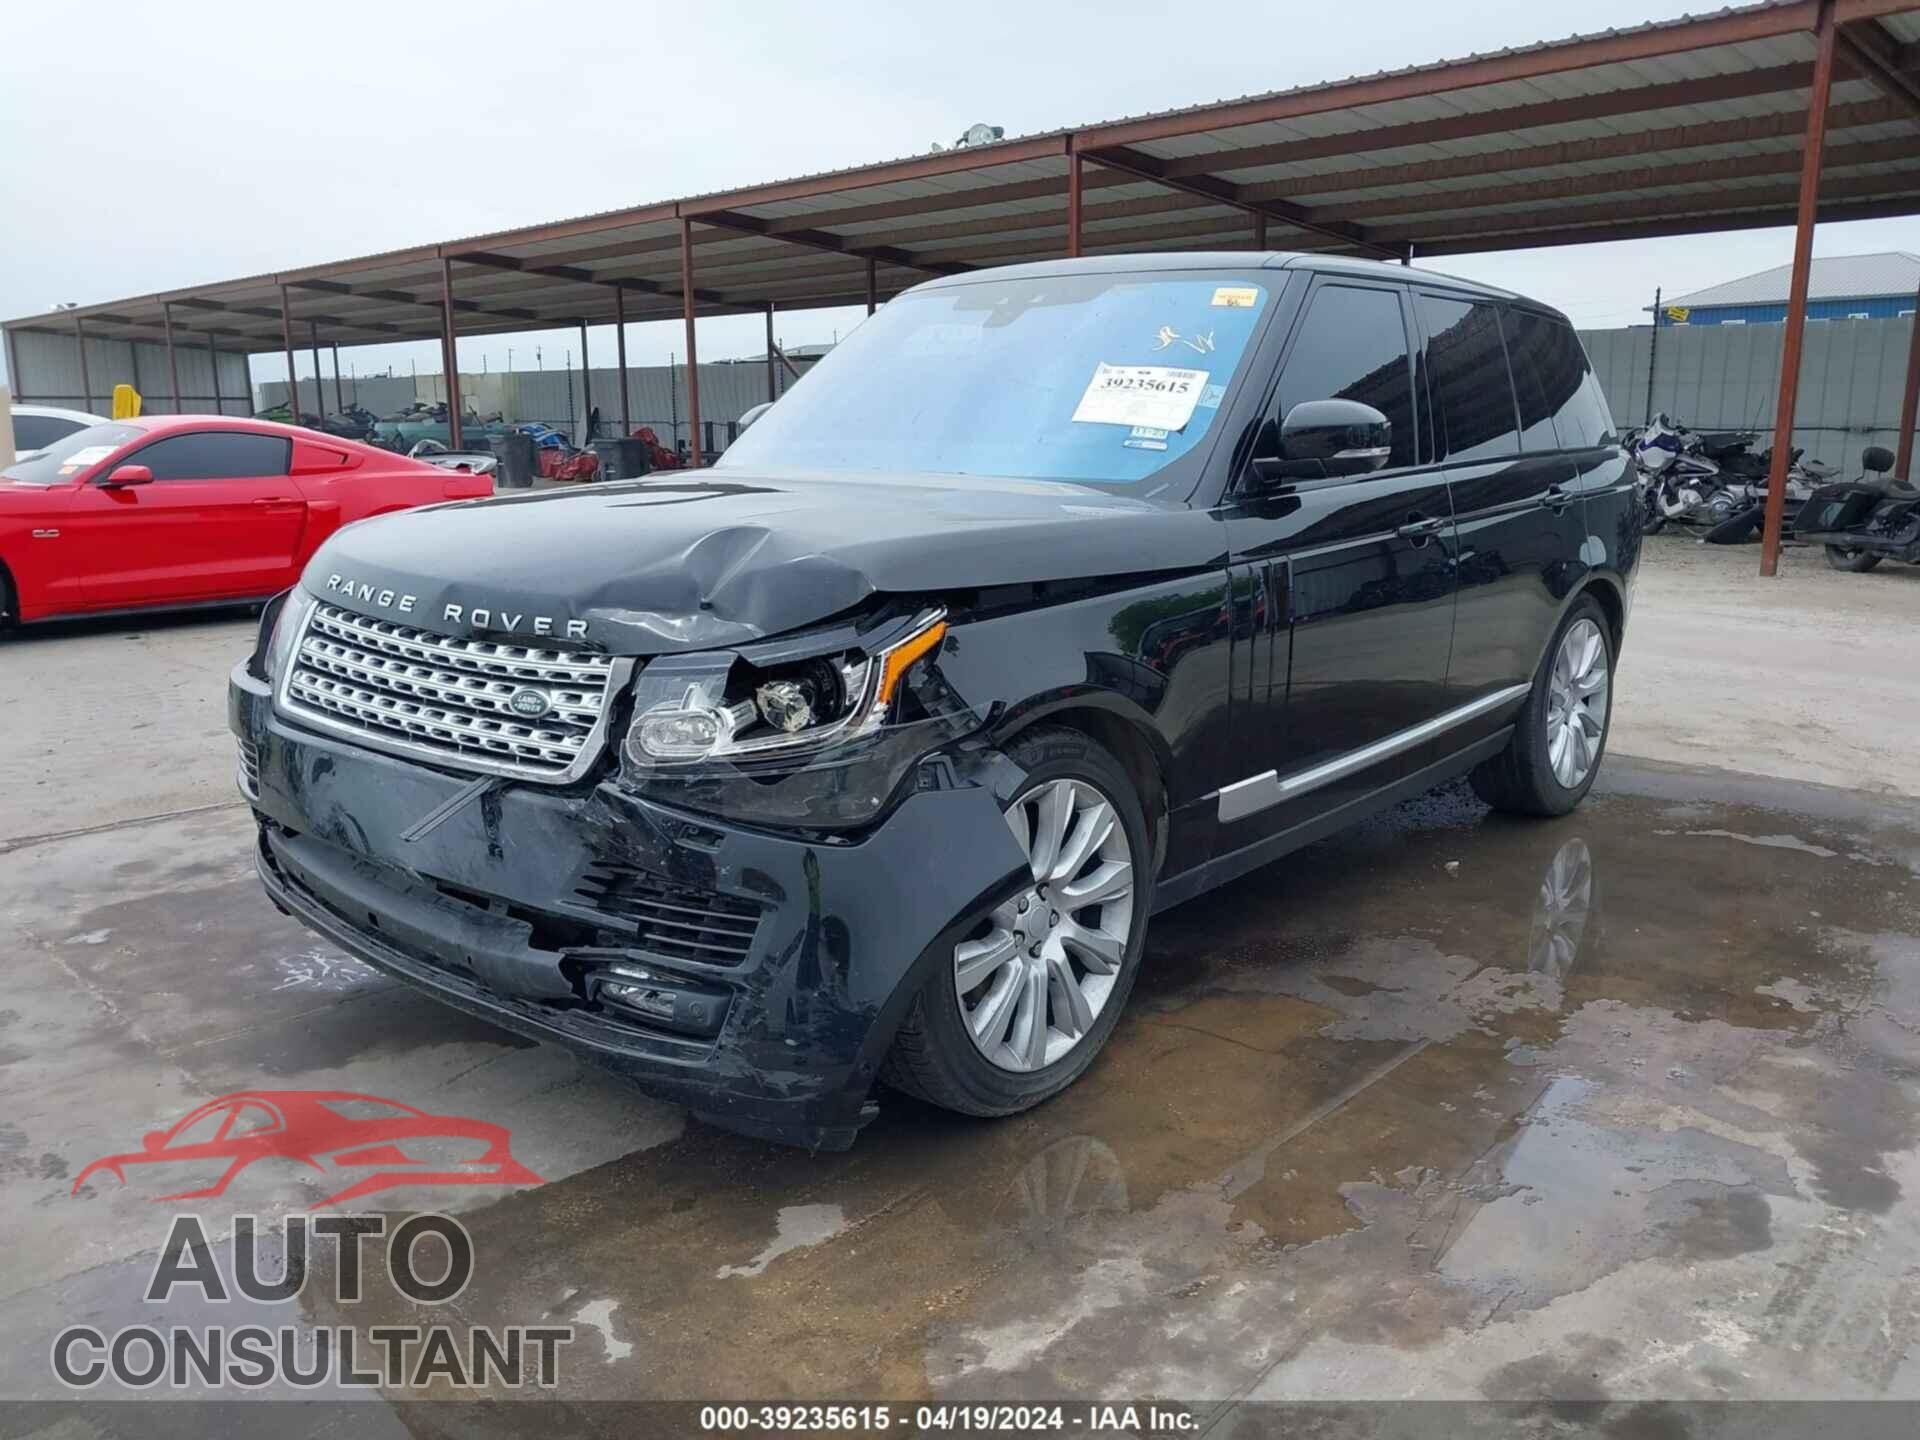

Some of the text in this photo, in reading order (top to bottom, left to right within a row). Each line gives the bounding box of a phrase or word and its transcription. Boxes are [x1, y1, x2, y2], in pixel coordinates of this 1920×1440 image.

[1100, 377, 1190, 394] 39235615
[327, 574, 588, 639] RANGE ROVER
